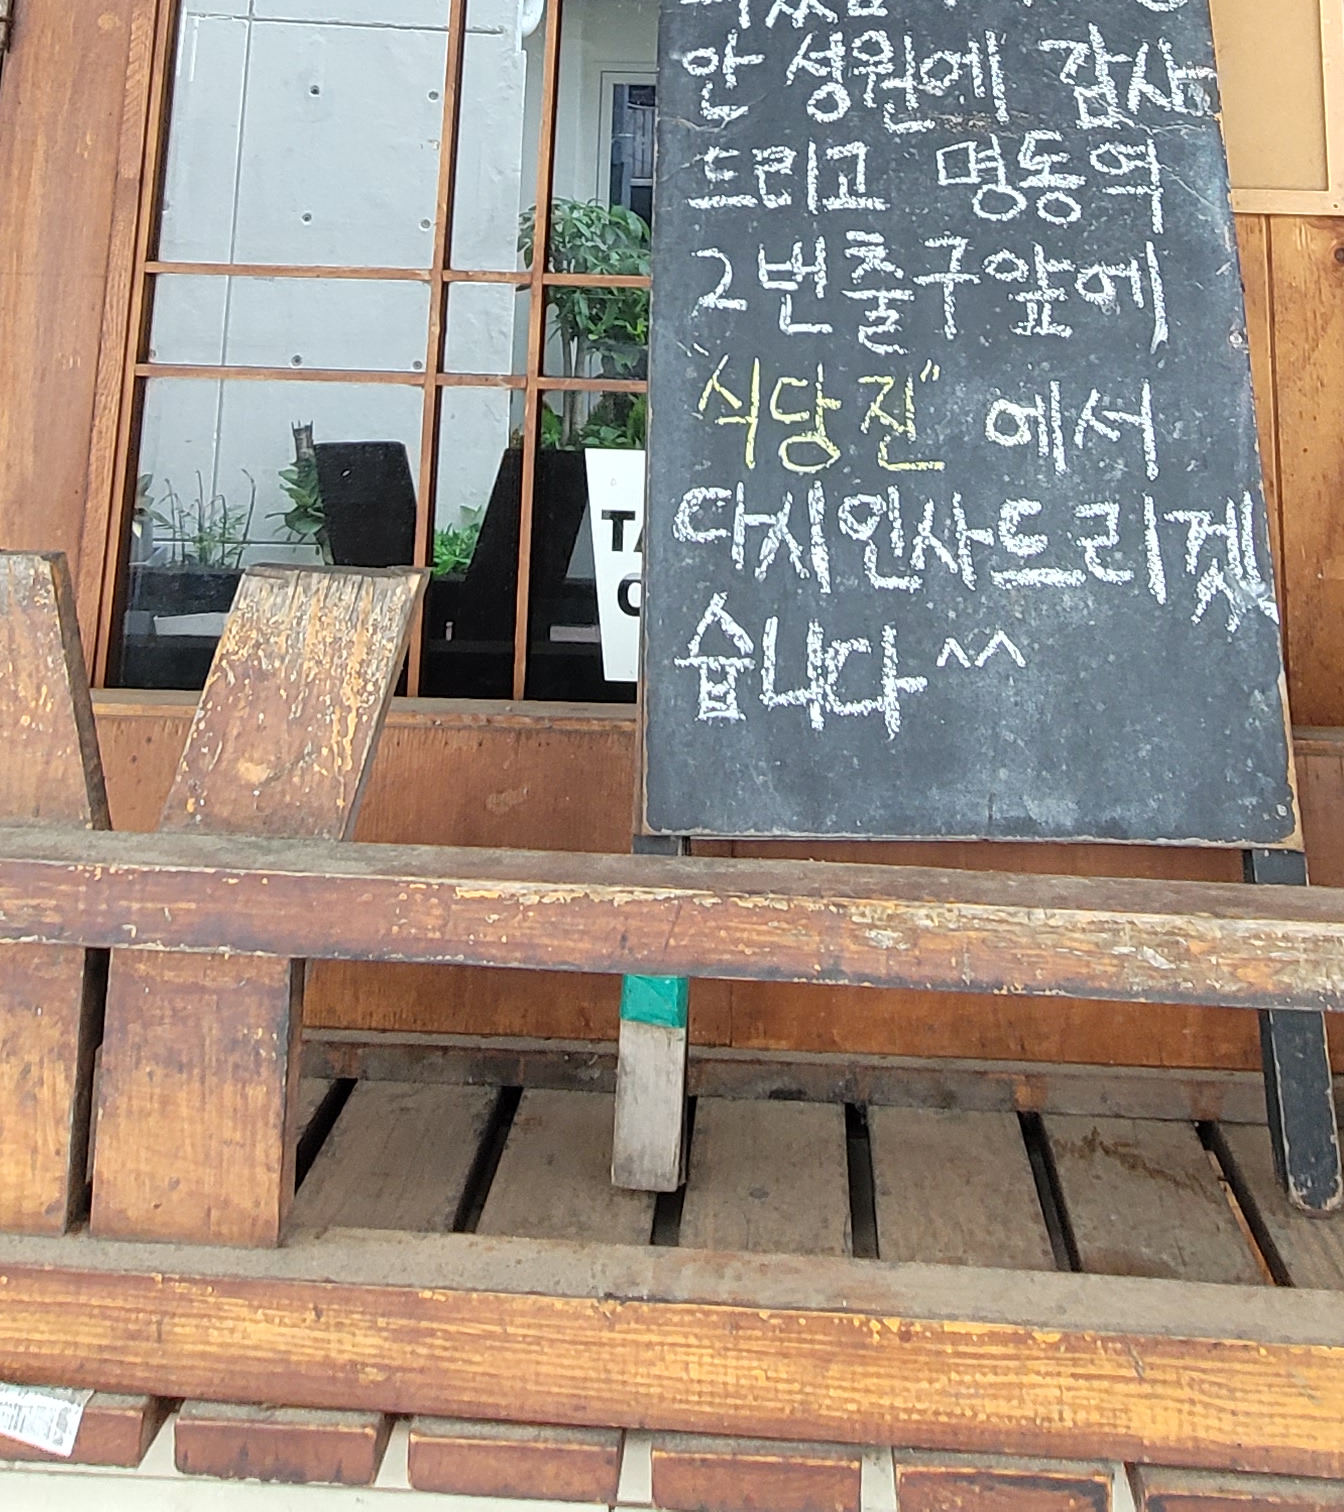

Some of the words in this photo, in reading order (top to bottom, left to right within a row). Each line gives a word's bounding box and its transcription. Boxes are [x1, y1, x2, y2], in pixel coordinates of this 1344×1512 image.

[681, 28, 765, 129] 안
[784, 28, 1011, 133] 성원에
[1038, 21, 1220, 131] 감사
[685, 135, 892, 216] 드리고
[934, 128, 1167, 235] 명동역
[983, 378, 1161, 482] 에서
